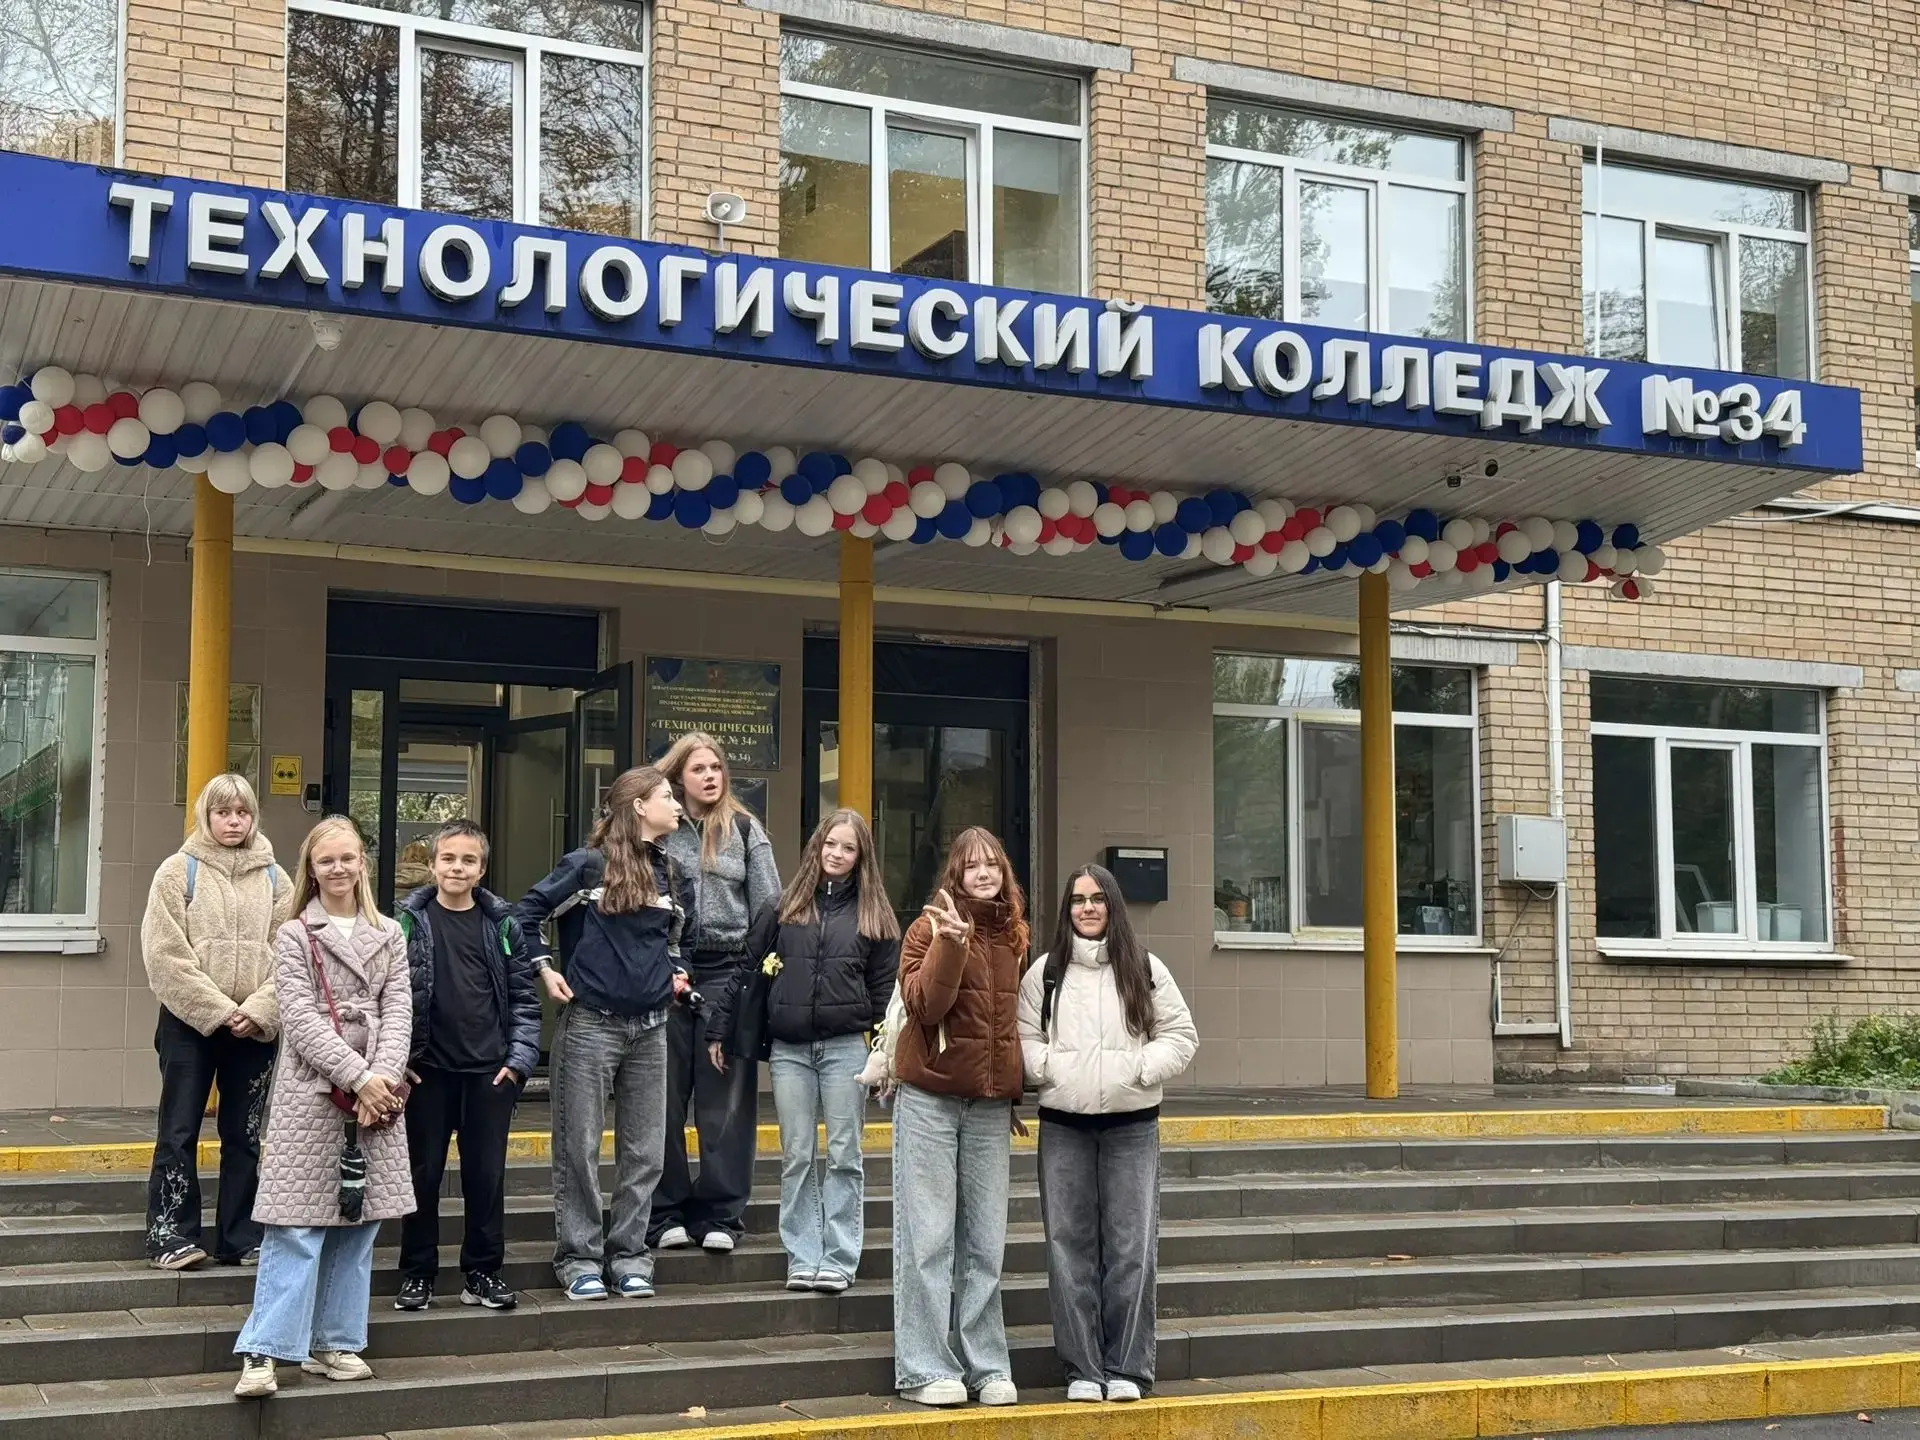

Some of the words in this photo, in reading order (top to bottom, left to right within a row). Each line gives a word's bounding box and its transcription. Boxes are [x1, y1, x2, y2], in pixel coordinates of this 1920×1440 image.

[109, 182, 1153, 382] ТЕХНОЛОГИЧЕСКИЙ
[1198, 323, 1612, 435] КОЛЛЕДЖ
[1641, 374, 1807, 448] №34
[651, 719, 774, 734] «ТЕХНОЛОГИЧЕСКИЙ
